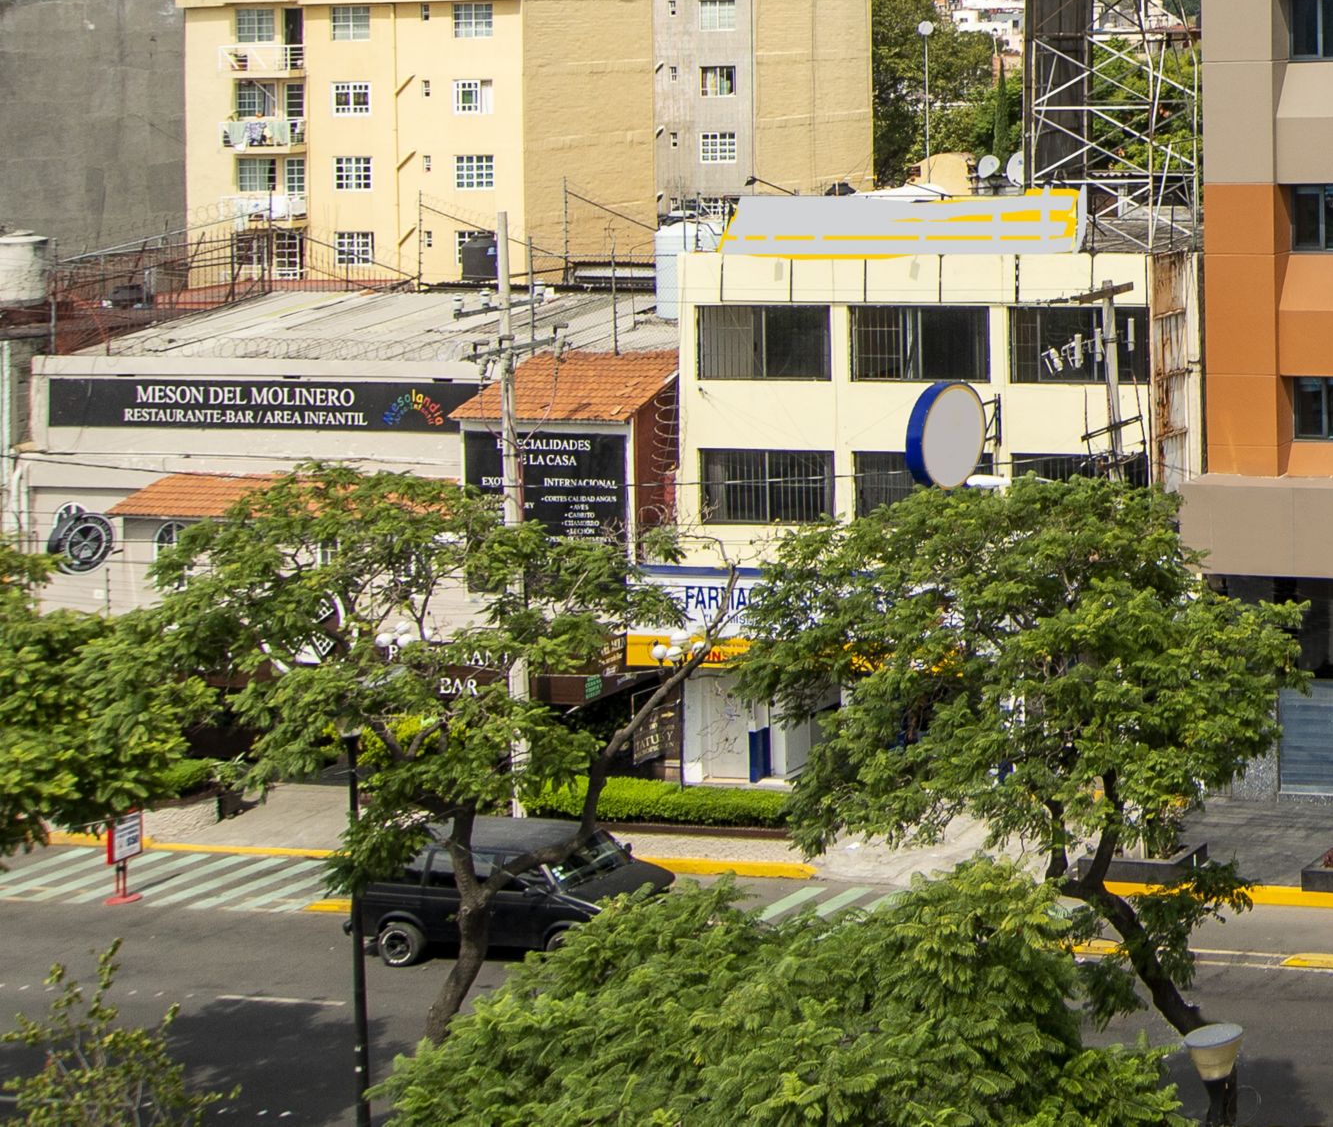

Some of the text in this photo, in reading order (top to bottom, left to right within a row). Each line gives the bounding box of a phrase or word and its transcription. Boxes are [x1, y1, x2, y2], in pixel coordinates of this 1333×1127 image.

[136, 385, 355, 406] MESON DEL MOLINERO
[383, 388, 444, 426] Mesolandia
[123, 408, 255, 423] RESTAURANTE-BAR
[264, 411, 301, 424] AREA
[304, 411, 368, 426] INFANTIL
[530, 454, 546, 465] LA
[547, 455, 577, 466] CASA
[544, 477, 618, 489] INTERNACIONAL
[440, 677, 478, 695] BAR
